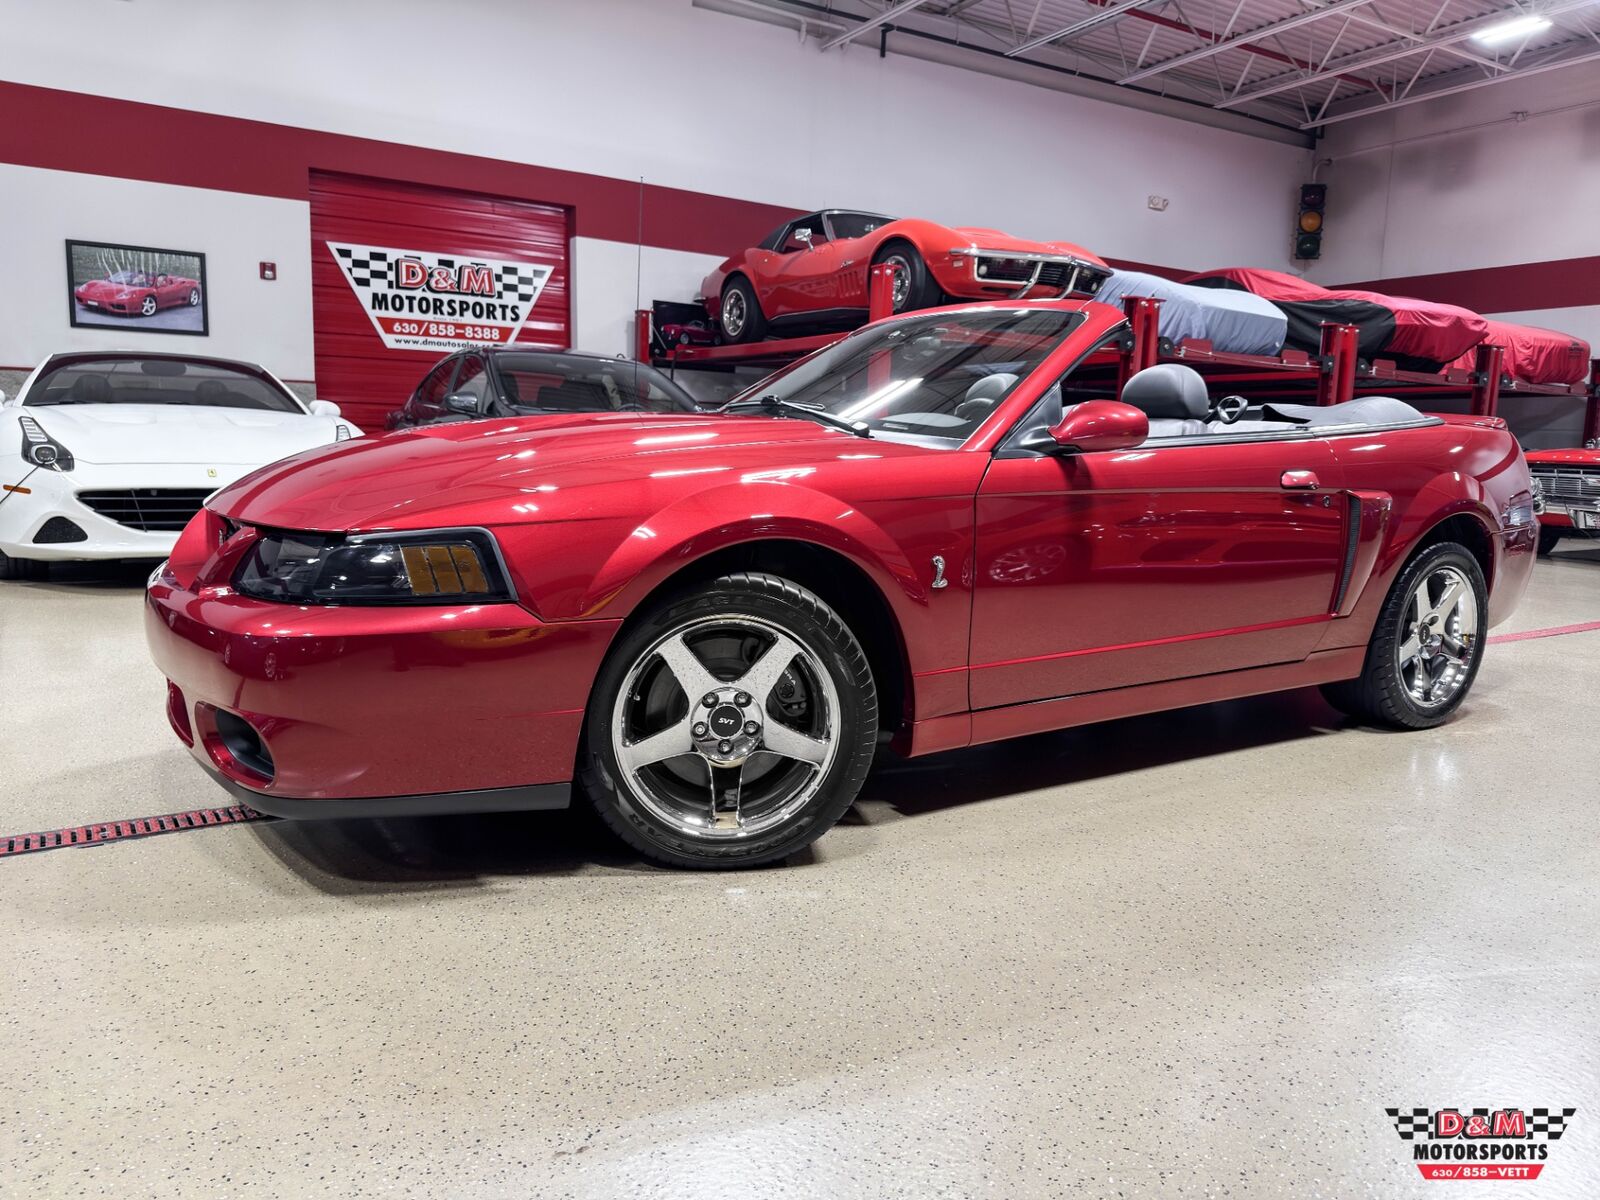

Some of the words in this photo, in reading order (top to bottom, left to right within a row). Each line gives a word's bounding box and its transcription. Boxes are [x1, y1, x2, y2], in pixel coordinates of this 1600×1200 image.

[396, 258, 496, 298] D&M
[371, 292, 520, 322] MOTORSPORTS
[393, 322, 500, 340] 630/858-8388
[718, 717, 735, 725] SVT
